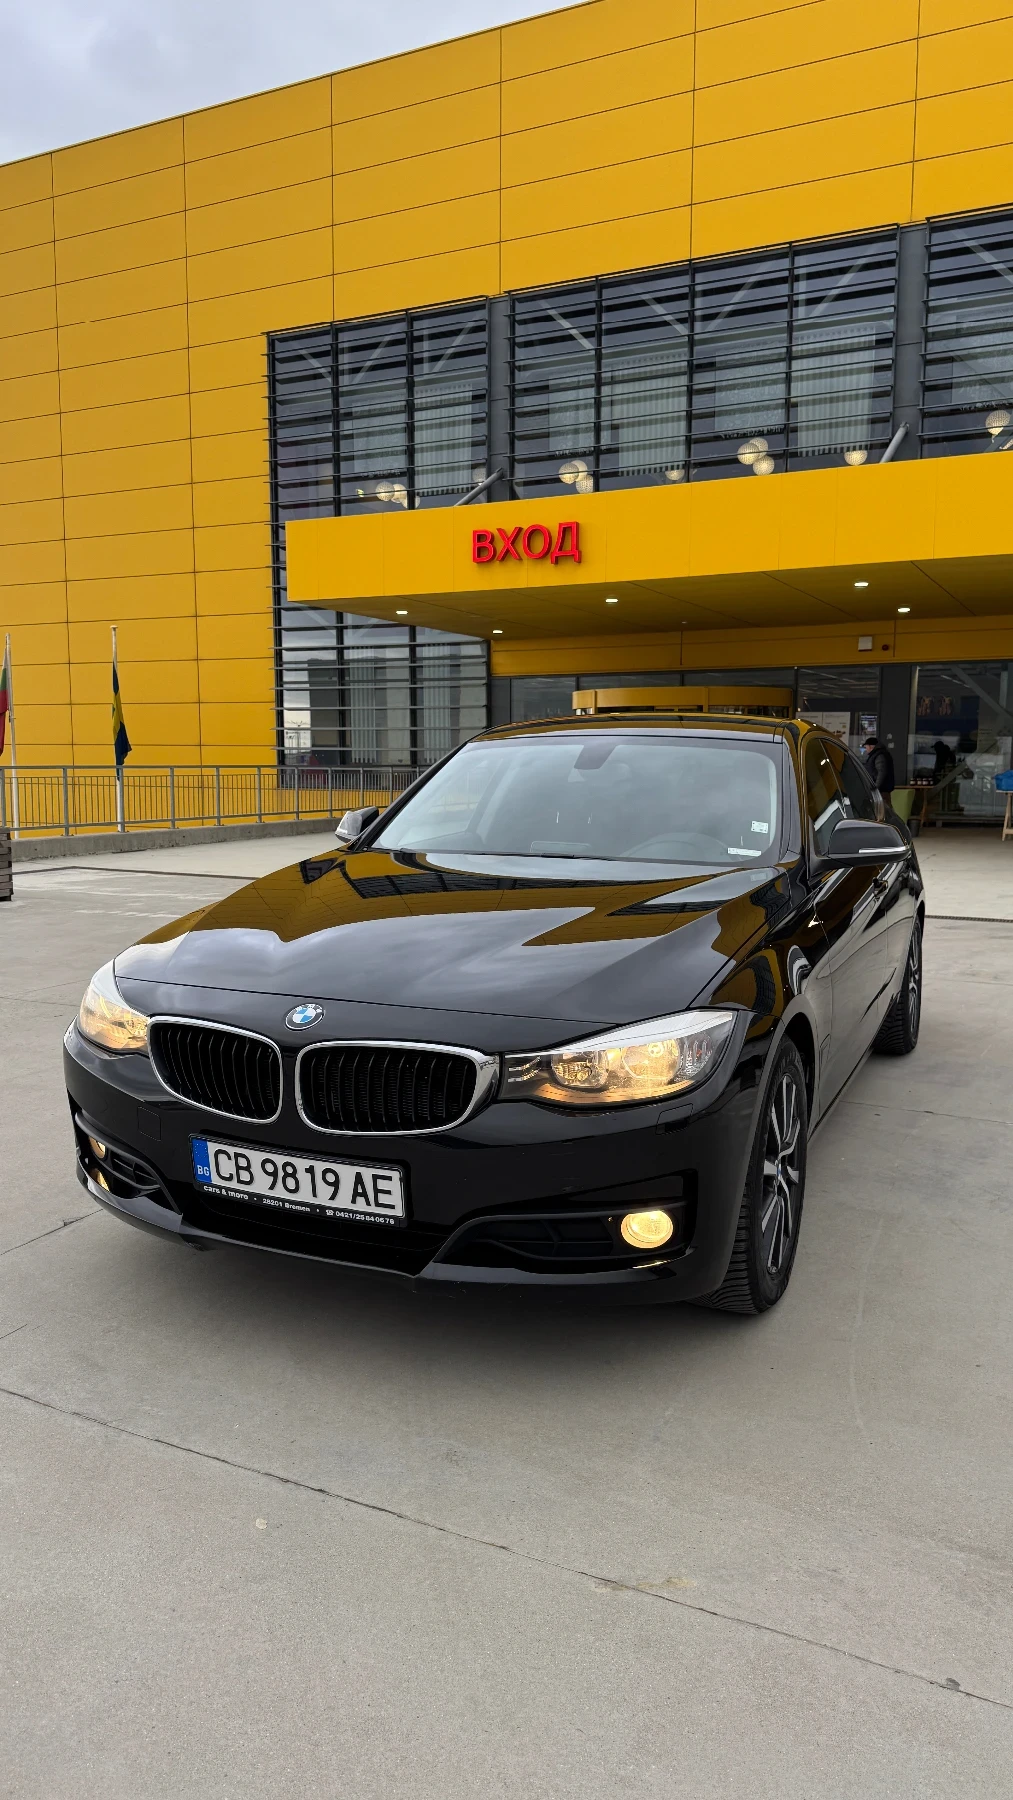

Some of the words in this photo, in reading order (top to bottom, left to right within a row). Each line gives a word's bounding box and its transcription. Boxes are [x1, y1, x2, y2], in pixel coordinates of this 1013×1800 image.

[472, 521, 582, 565] ВХОД
[197, 1164, 210, 1177] BG
[213, 1149, 255, 1186] CB
[260, 1157, 340, 1201] 9819
[350, 1171, 396, 1210] AE
[203, 1185, 220, 1194] cars
[221, 1188, 227, 1196] &
[284, 1202, 311, 1212] Bremen
